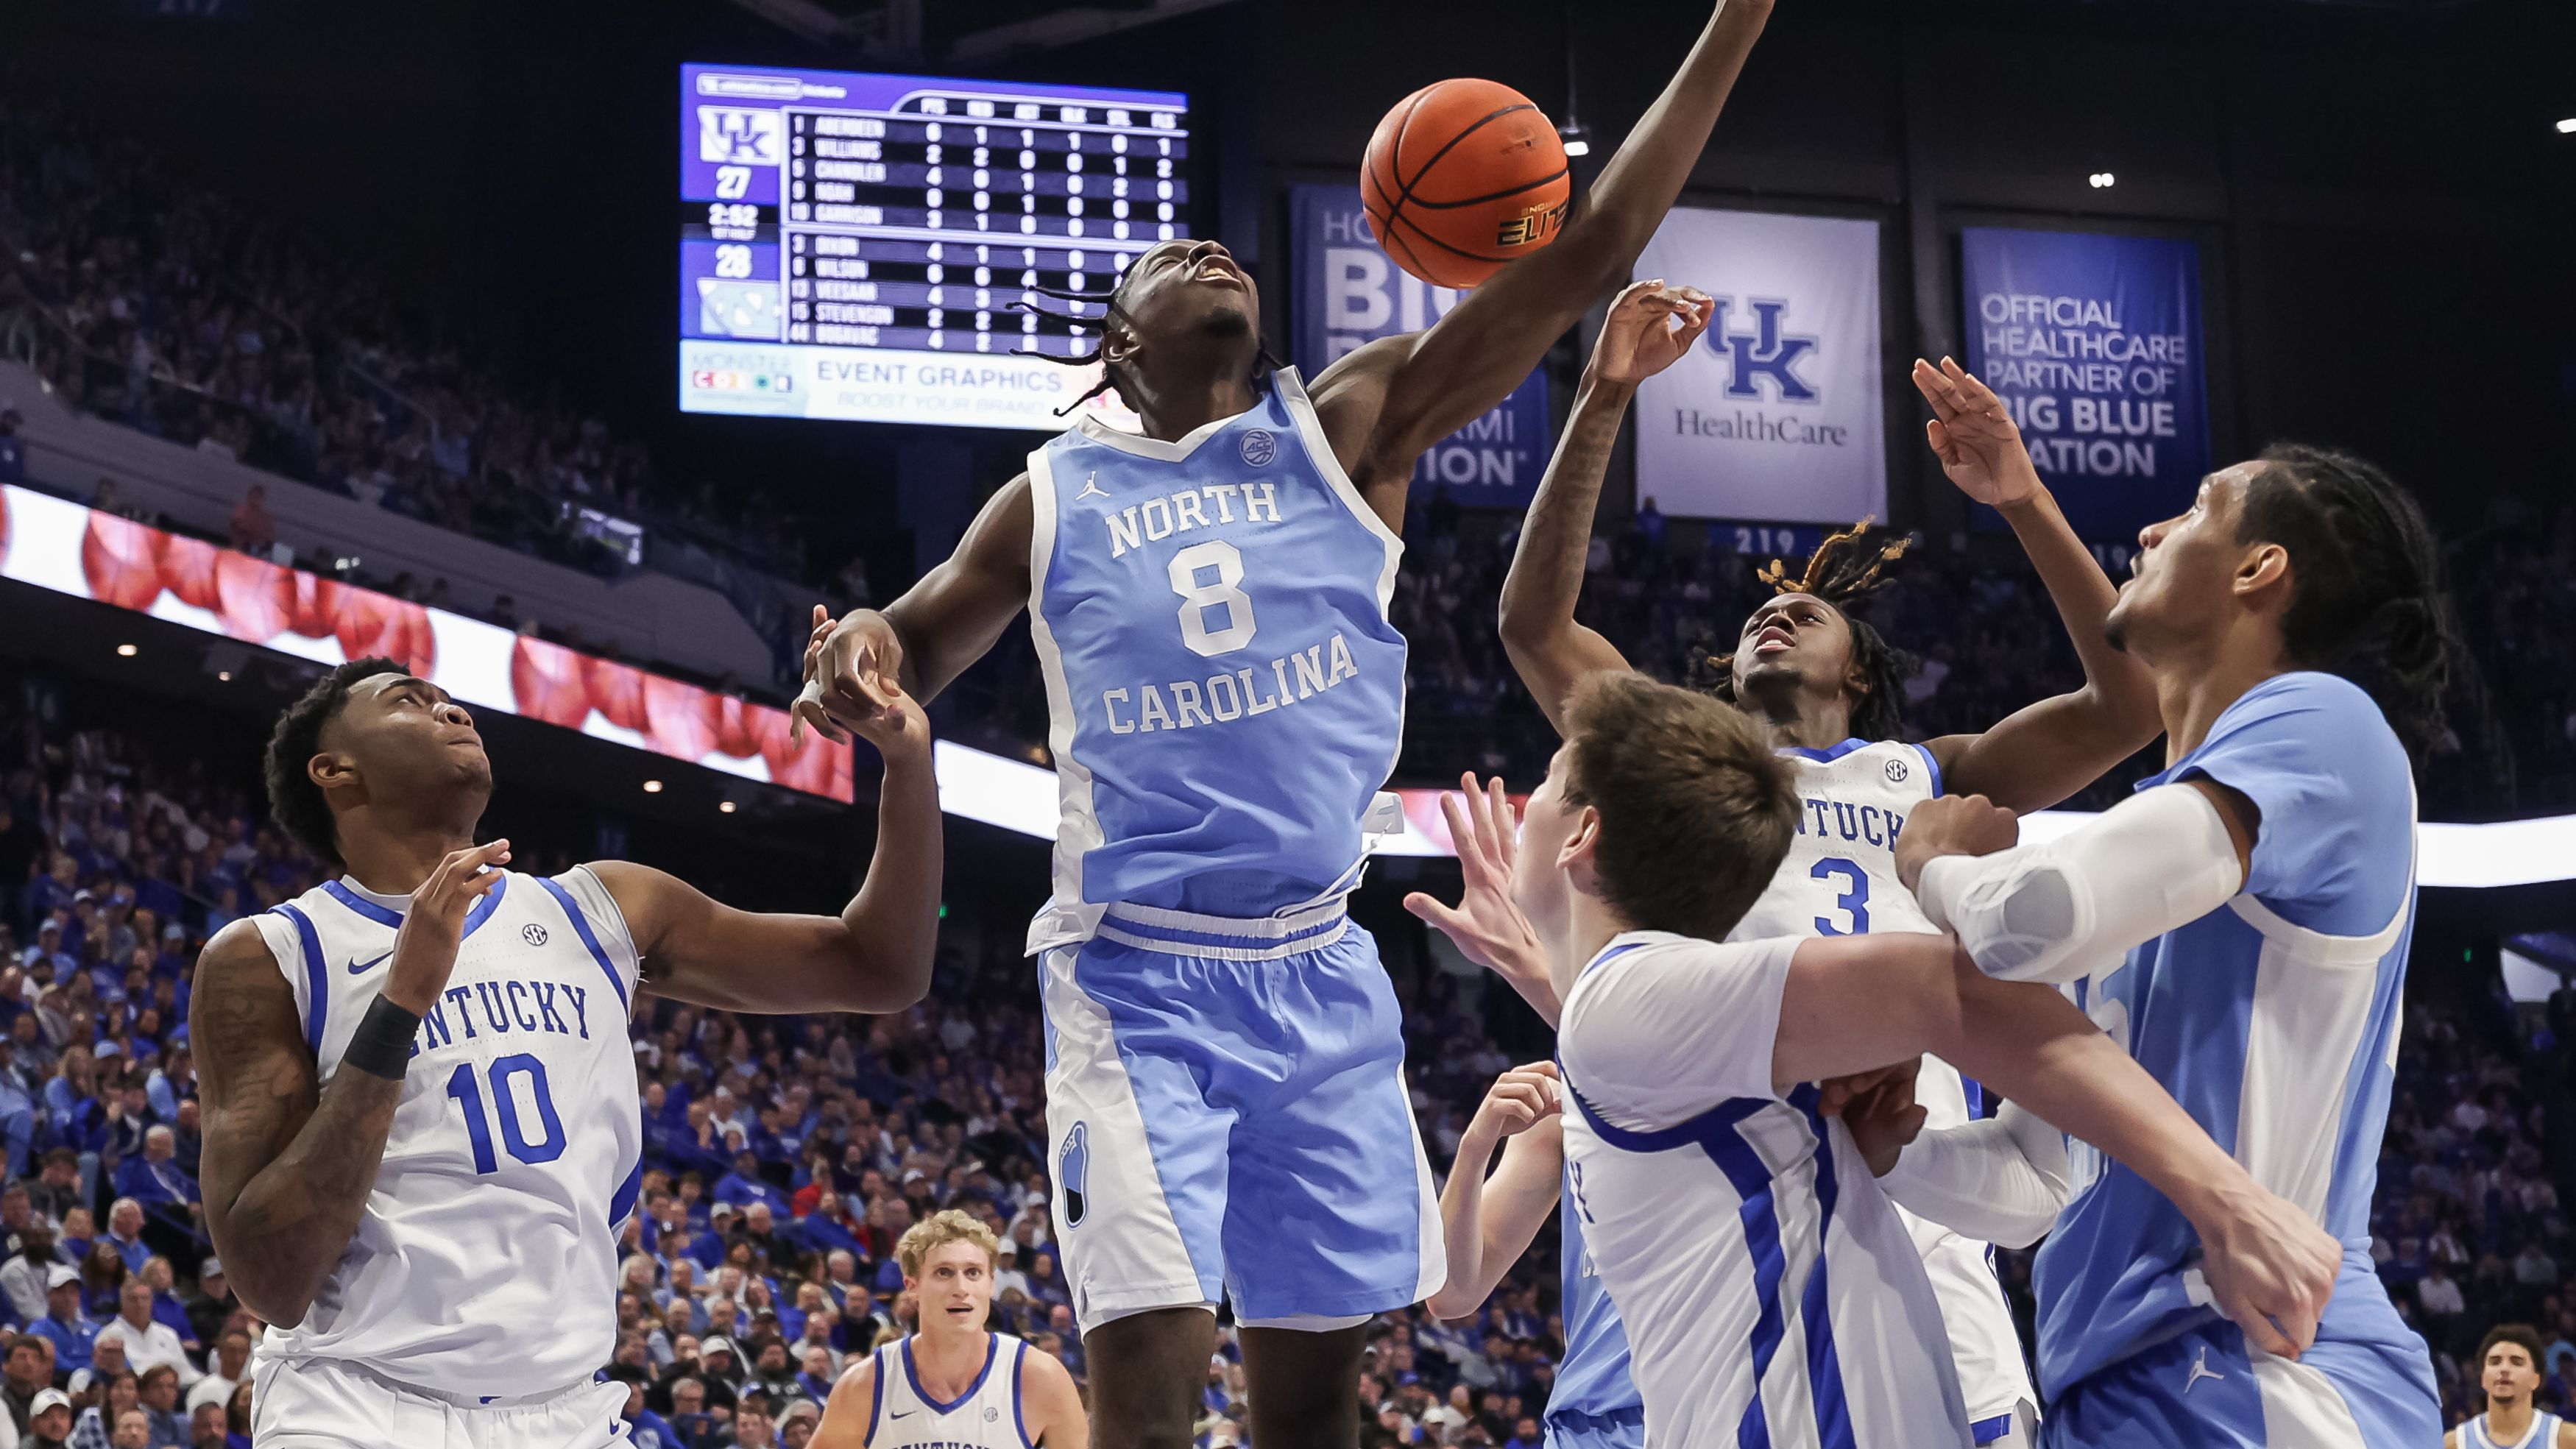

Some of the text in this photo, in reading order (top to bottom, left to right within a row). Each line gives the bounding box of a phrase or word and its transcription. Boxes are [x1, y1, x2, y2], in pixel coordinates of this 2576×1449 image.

[715, 165, 752, 199] 27
[815, 302, 894, 325] STEVENSON
[1981, 293, 2123, 330] OFFICIAL
[1983, 325, 2187, 365] HEALTHCARE
[817, 360, 907, 383] EVENT
[918, 365, 1063, 393] GRAPHICS
[1986, 359, 2176, 396] PARTNER OF
[837, 391, 1046, 416] BOOST YOUR BRAND
[2071, 397, 2176, 437] BLUE
[1676, 408, 1848, 446] HealthCare
[2029, 438, 2155, 477] ATION
[1105, 483, 1283, 559] NORTH
[1735, 527, 1794, 556] 219
[1167, 539, 1257, 657] 8
[1103, 634, 1359, 734] CAROLINA
[1886, 761, 1907, 781] SEC
[1811, 857, 1870, 937] 3
[523, 924, 547, 946] SEC
[420, 980, 589, 1052] NTUCKY
[446, 1052, 567, 1175] 10
